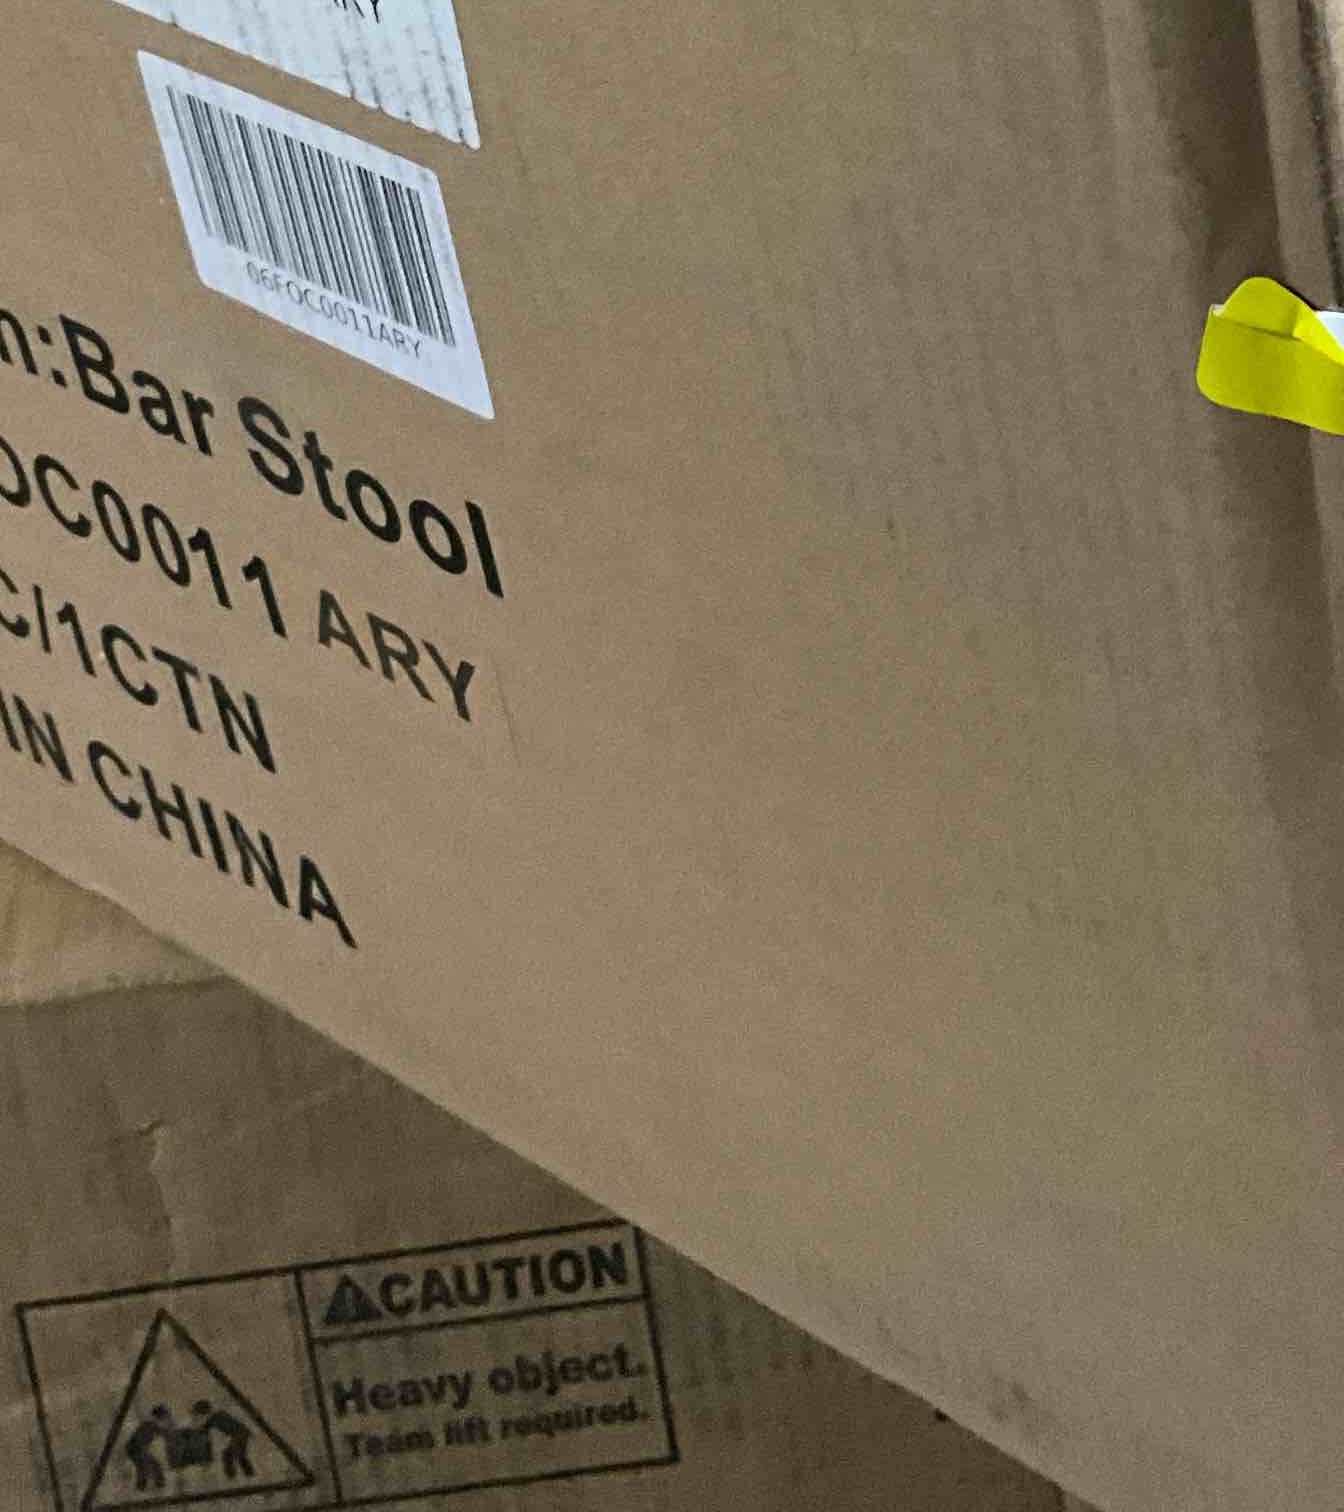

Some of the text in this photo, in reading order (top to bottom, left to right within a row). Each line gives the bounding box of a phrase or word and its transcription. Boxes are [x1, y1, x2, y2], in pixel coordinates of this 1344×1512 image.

[238, 396, 504, 599] Stool
[315, 589, 476, 724] ARY
[87, 740, 359, 949] CHINA
[379, 1241, 628, 1316] CAUTION
[332, 1341, 647, 1417] Heavy object.
[344, 1428, 435, 1458] Team
[443, 1414, 491, 1446] lift
